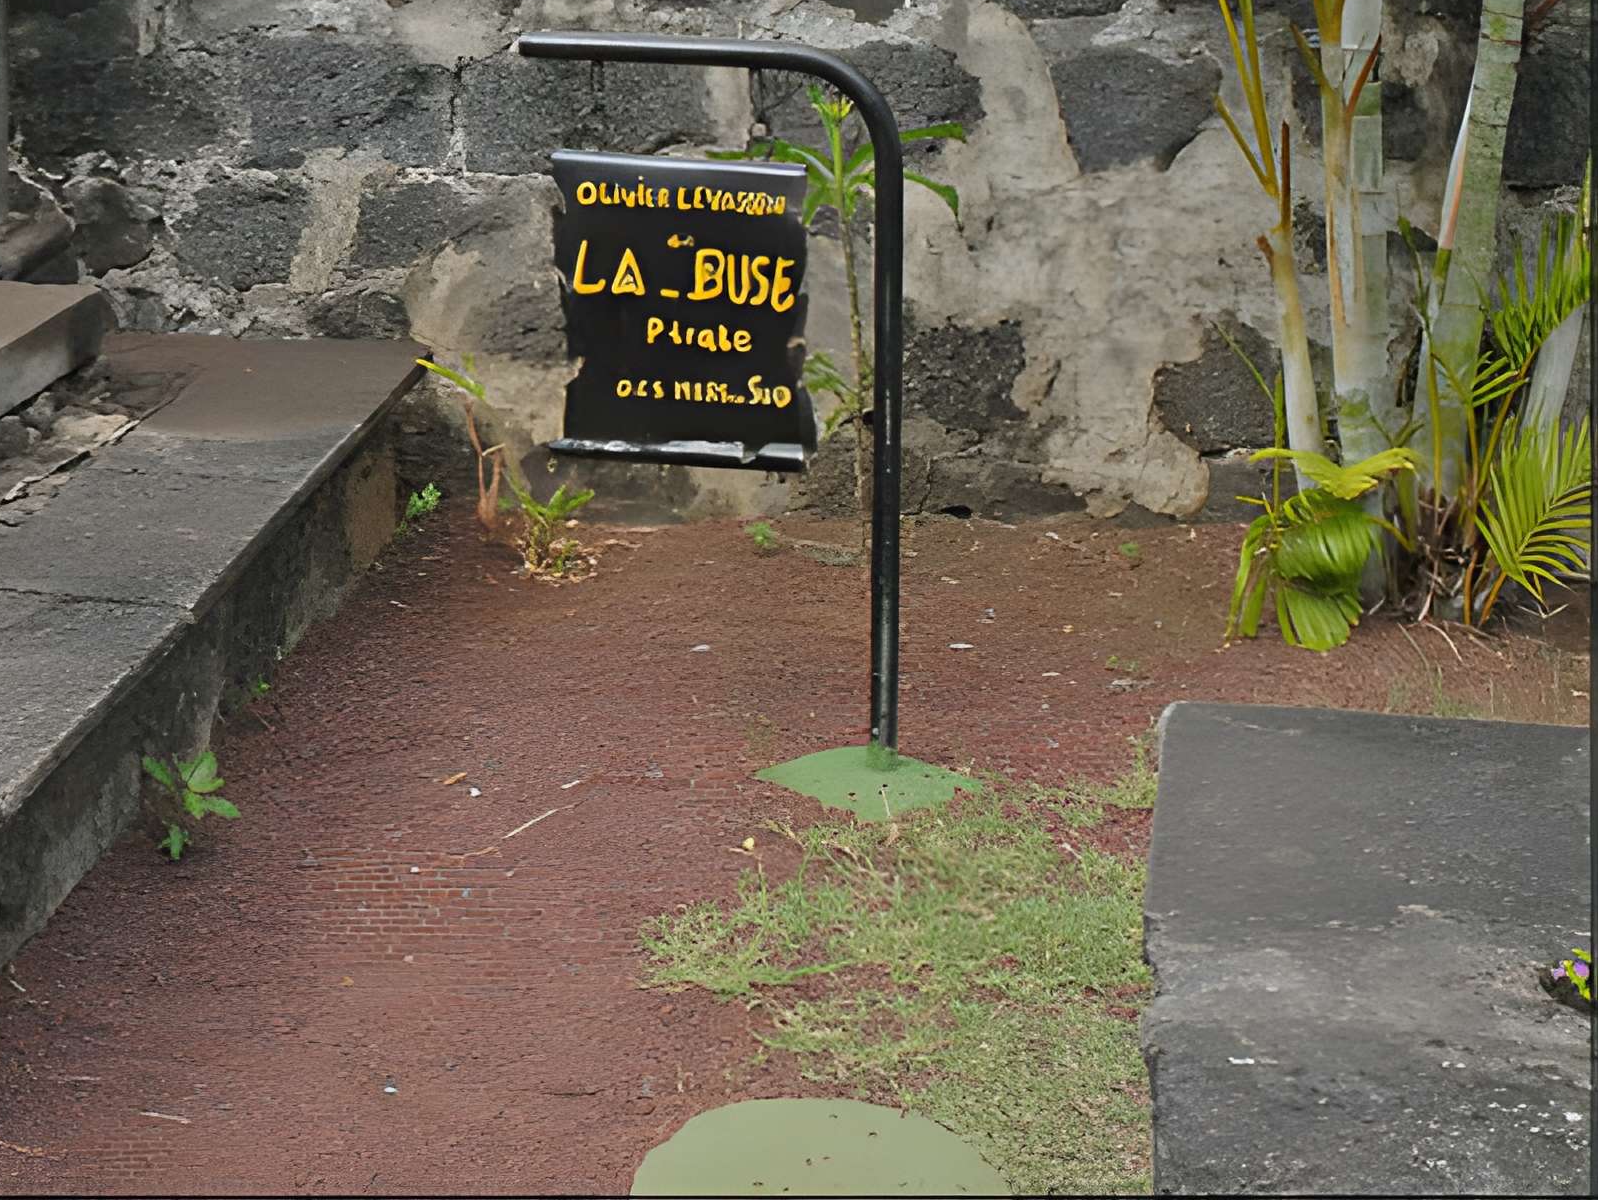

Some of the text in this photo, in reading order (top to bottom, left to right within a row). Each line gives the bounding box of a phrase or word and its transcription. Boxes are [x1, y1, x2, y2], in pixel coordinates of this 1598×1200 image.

[572, 239, 646, 296] LA
[686, 248, 796, 313] BUSE
[646, 316, 752, 353] Pirate
